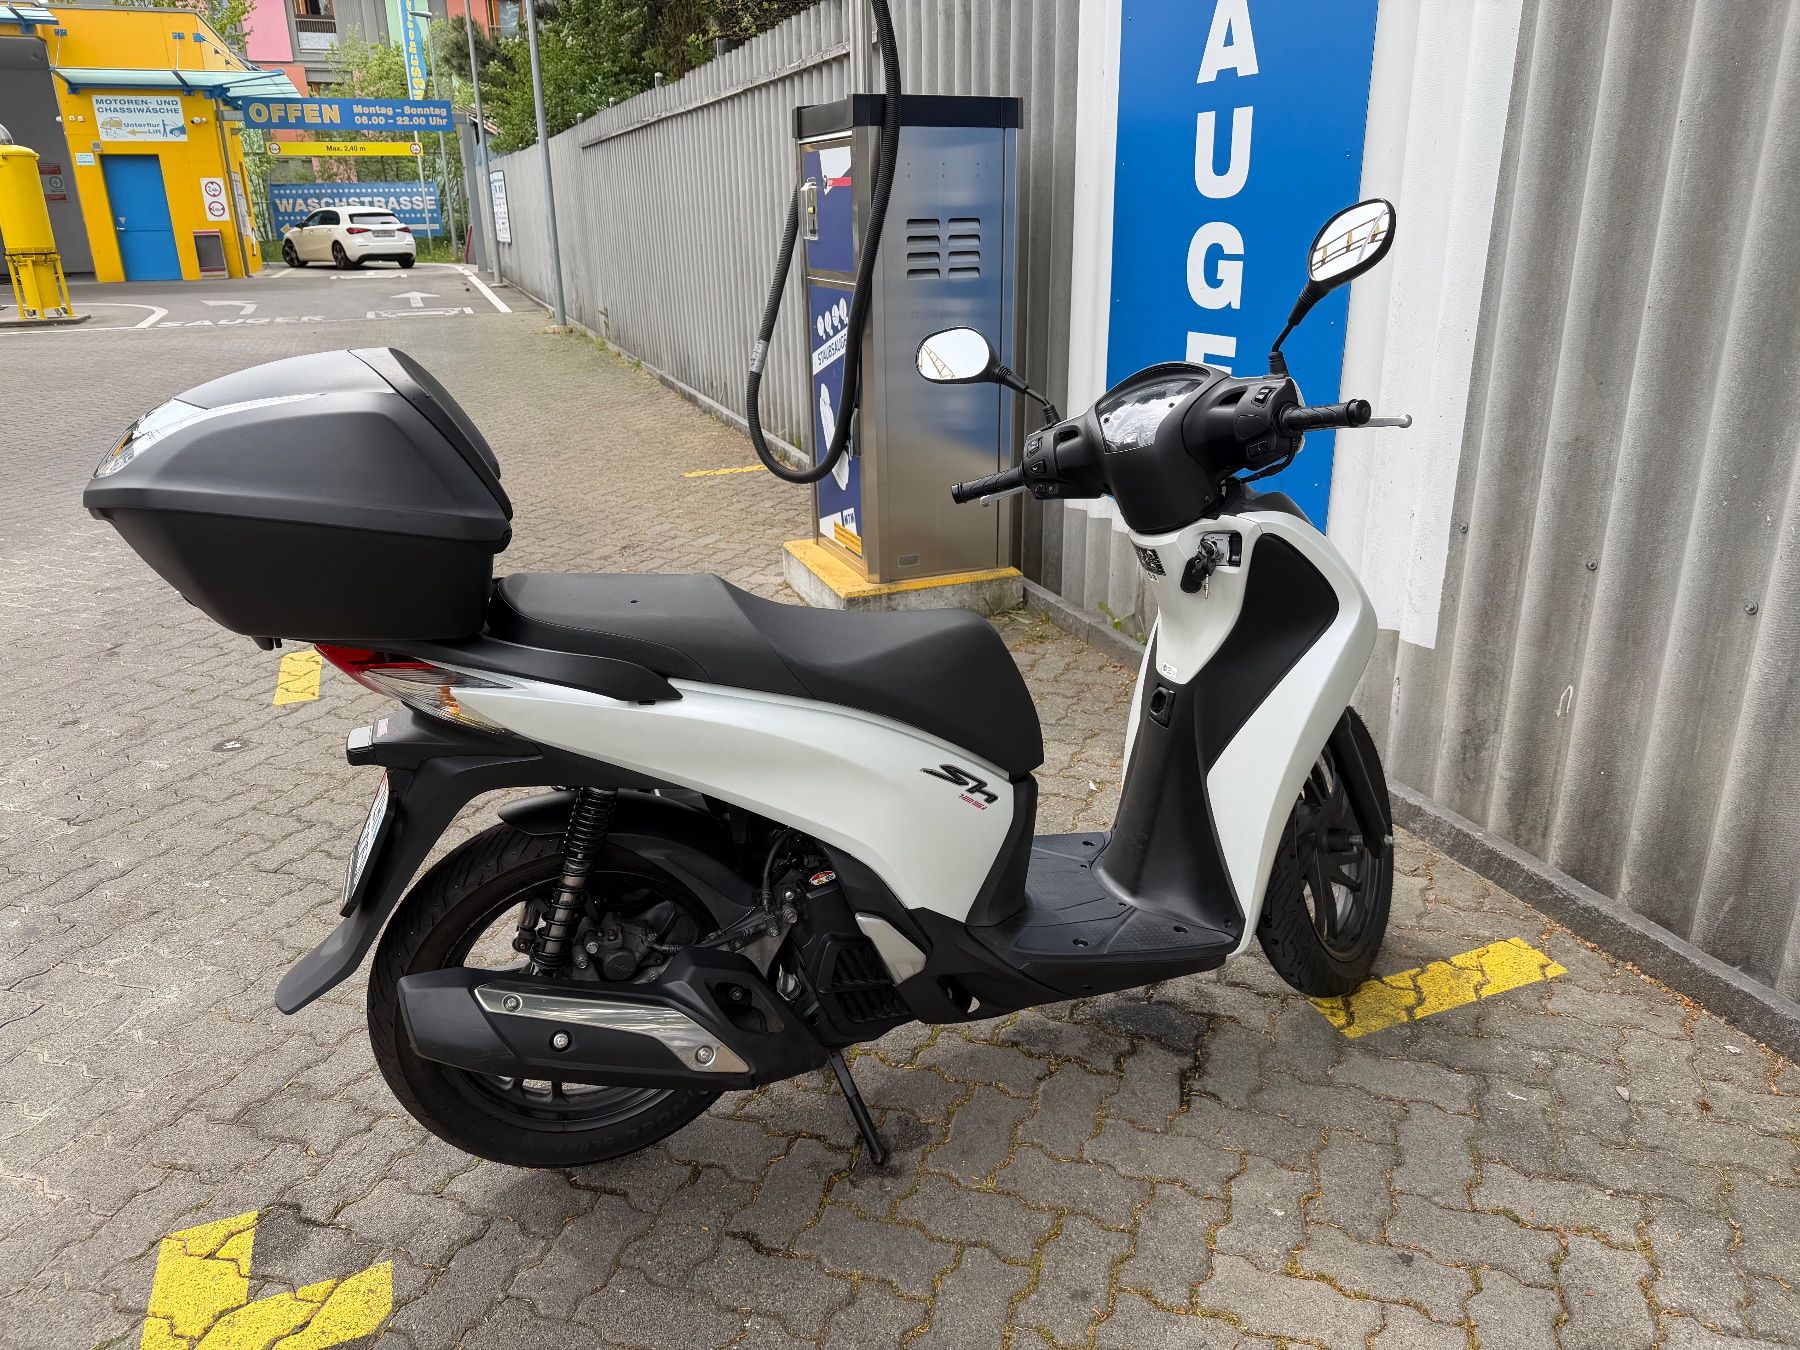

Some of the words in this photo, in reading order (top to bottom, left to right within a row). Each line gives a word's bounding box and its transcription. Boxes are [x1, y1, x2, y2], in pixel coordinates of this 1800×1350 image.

[248, 102, 341, 124] OFFEN
[352, 104, 393, 115] Montag
[403, 105, 447, 116] Sonntag
[396, 116, 426, 125] 22.00
[428, 116, 448, 125] Uhr
[275, 195, 437, 212] WASCHSTRASSE
[817, 332, 847, 366] STAUBSAUGE
